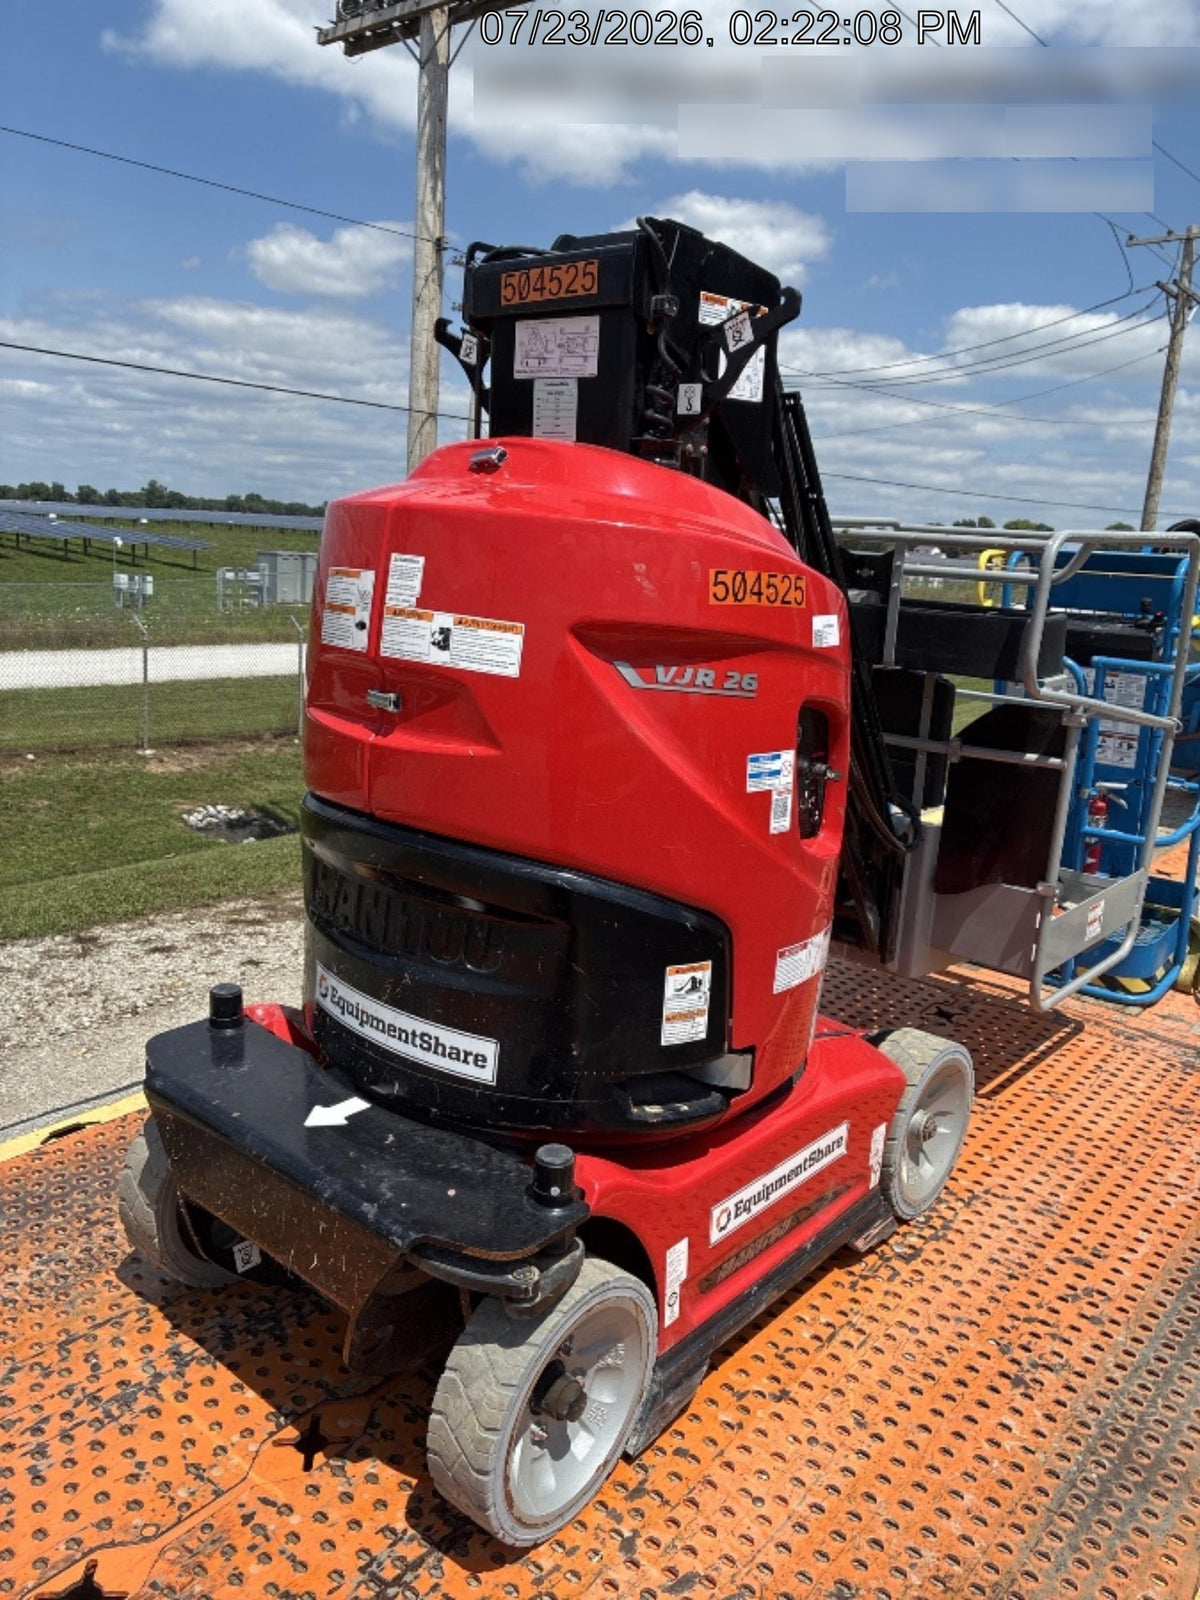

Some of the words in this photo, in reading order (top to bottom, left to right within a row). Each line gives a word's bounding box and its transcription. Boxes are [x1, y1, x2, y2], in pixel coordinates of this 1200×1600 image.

[502, 260, 598, 304] 504525
[712, 569, 805, 606] 504525
[654, 663, 716, 688] VJR
[722, 671, 759, 692] 26
[330, 984, 489, 1070] EquipmentShare
[732, 1134, 844, 1220] EquipmentShare
